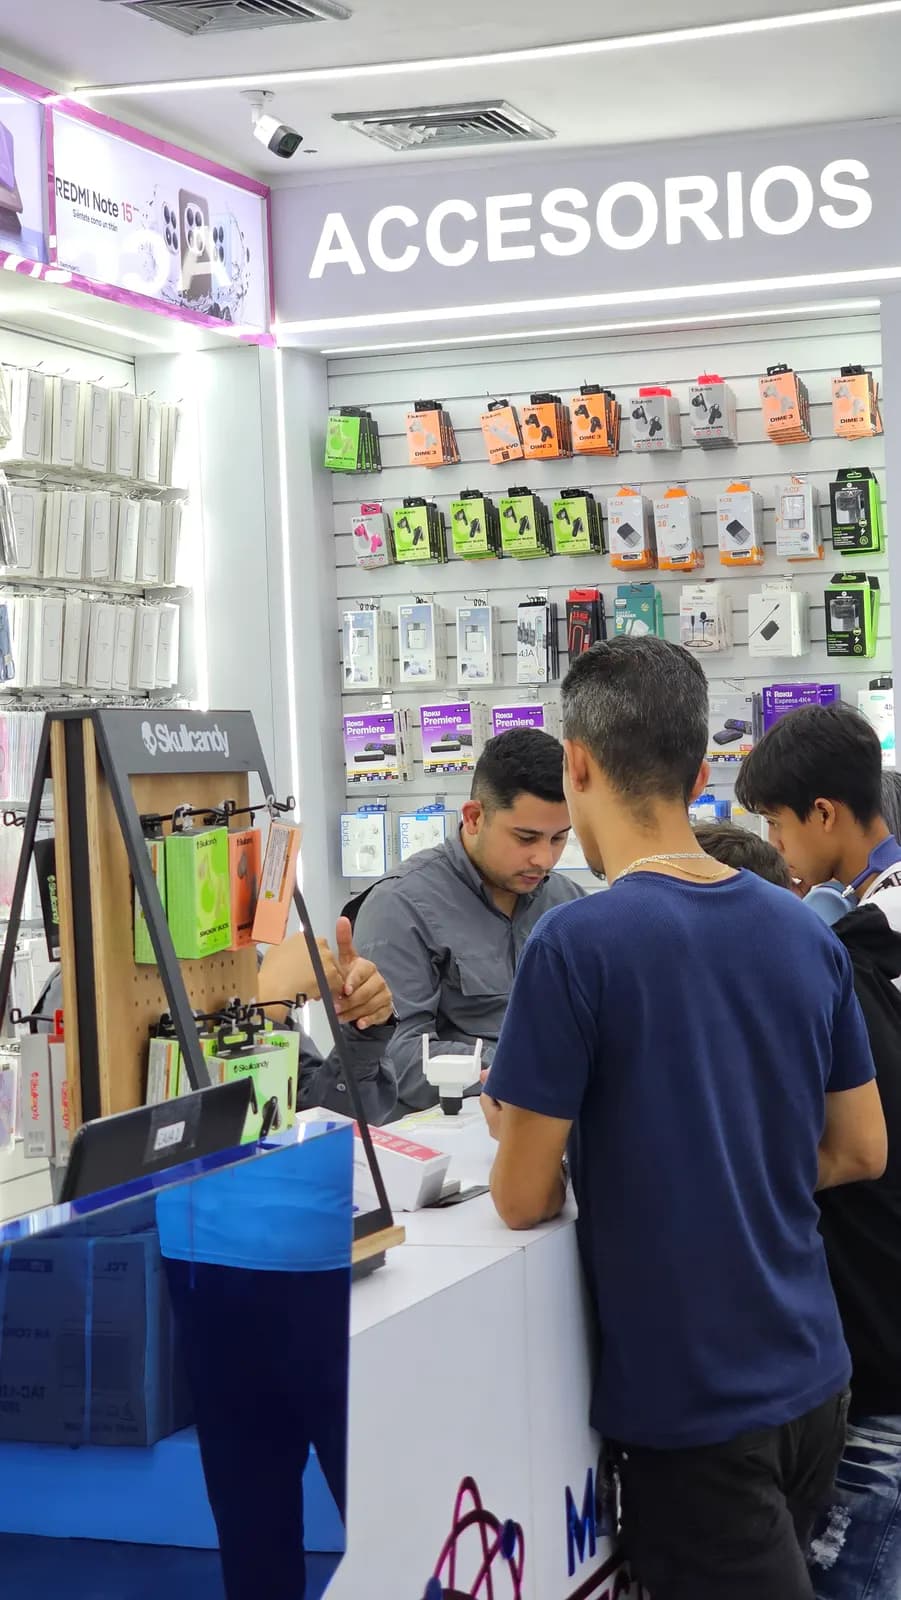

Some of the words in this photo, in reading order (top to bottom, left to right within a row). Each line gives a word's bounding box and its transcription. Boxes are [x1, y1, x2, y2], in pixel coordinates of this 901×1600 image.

[56, 177, 90, 208] REDMI
[92, 191, 119, 218] Note
[121, 202, 133, 223] 15
[308, 158, 873, 279] ACCESORIOS
[770, 415, 787, 423] DIME
[774, 697, 798, 705] Express
[423, 716, 462, 726] Premiere
[495, 718, 535, 728] Premiere
[346, 726, 386, 736] Premiere
[155, 723, 229, 758] Skullcandy
[342, 821, 351, 848] buds
[401, 822, 410, 849] buds
